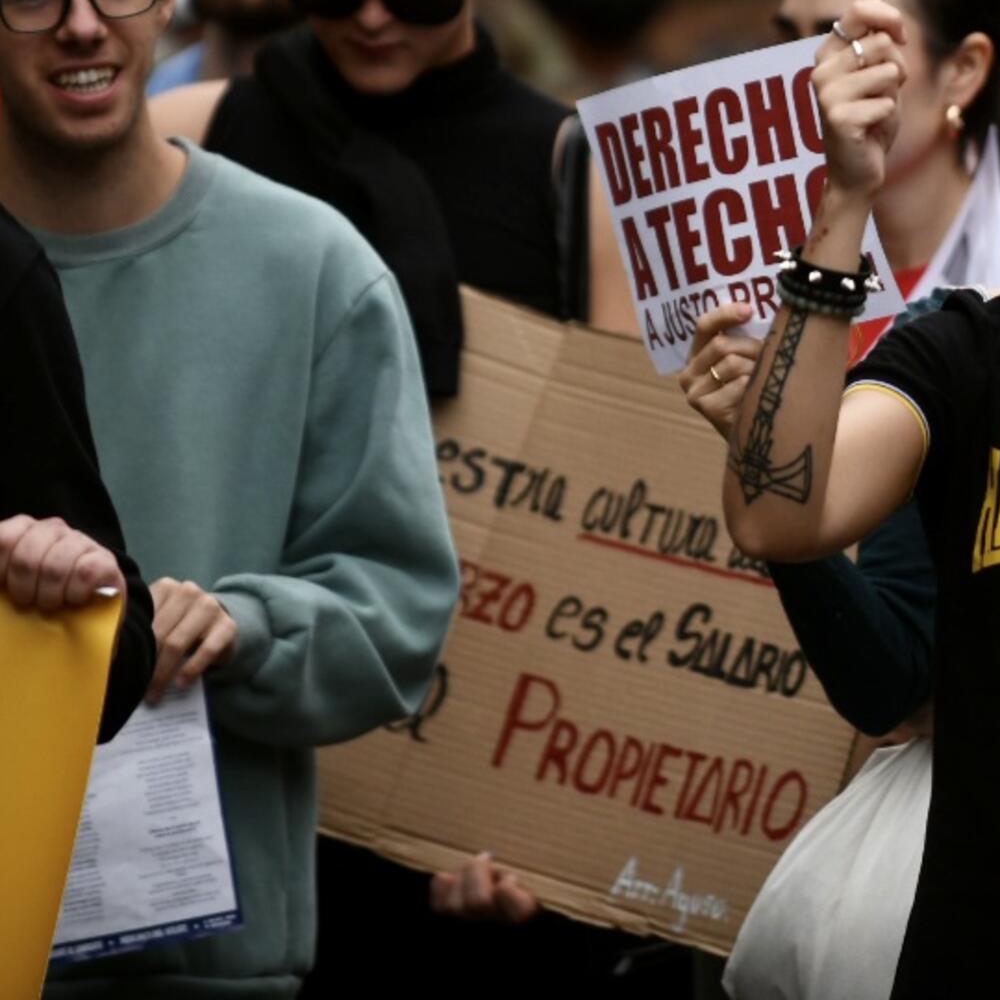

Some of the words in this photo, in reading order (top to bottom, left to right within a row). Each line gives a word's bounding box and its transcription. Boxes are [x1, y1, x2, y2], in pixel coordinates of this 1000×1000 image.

[644, 309, 662, 351] A
[545, 595, 608, 652] es
[614, 611, 664, 663] el
